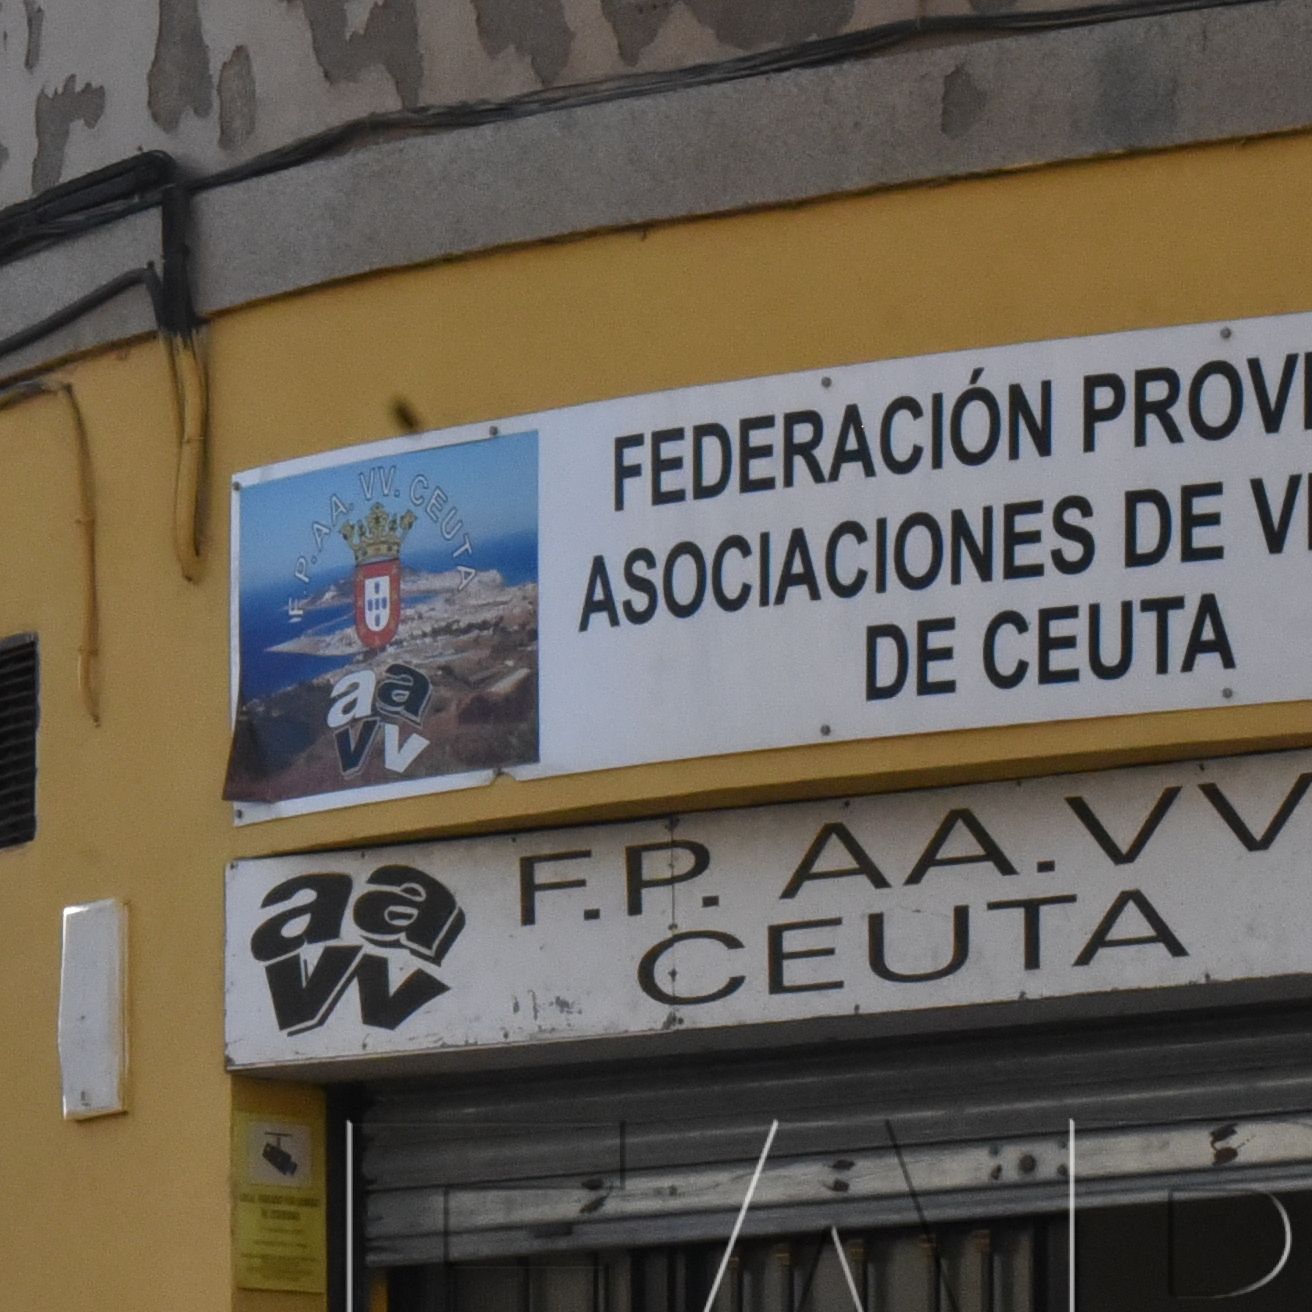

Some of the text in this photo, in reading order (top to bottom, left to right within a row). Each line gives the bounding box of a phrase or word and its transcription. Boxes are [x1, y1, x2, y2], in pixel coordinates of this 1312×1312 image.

[614, 367, 1053, 512] FEDERACIÓN
[409, 473, 477, 591] CEUTA
[579, 495, 1096, 632] ASOCIACIONES
[1124, 481, 1225, 569] DE
[866, 592, 1236, 702] DE CEUTA
[520, 838, 720, 927] F.P.
[637, 888, 1191, 1006] CEUTA
